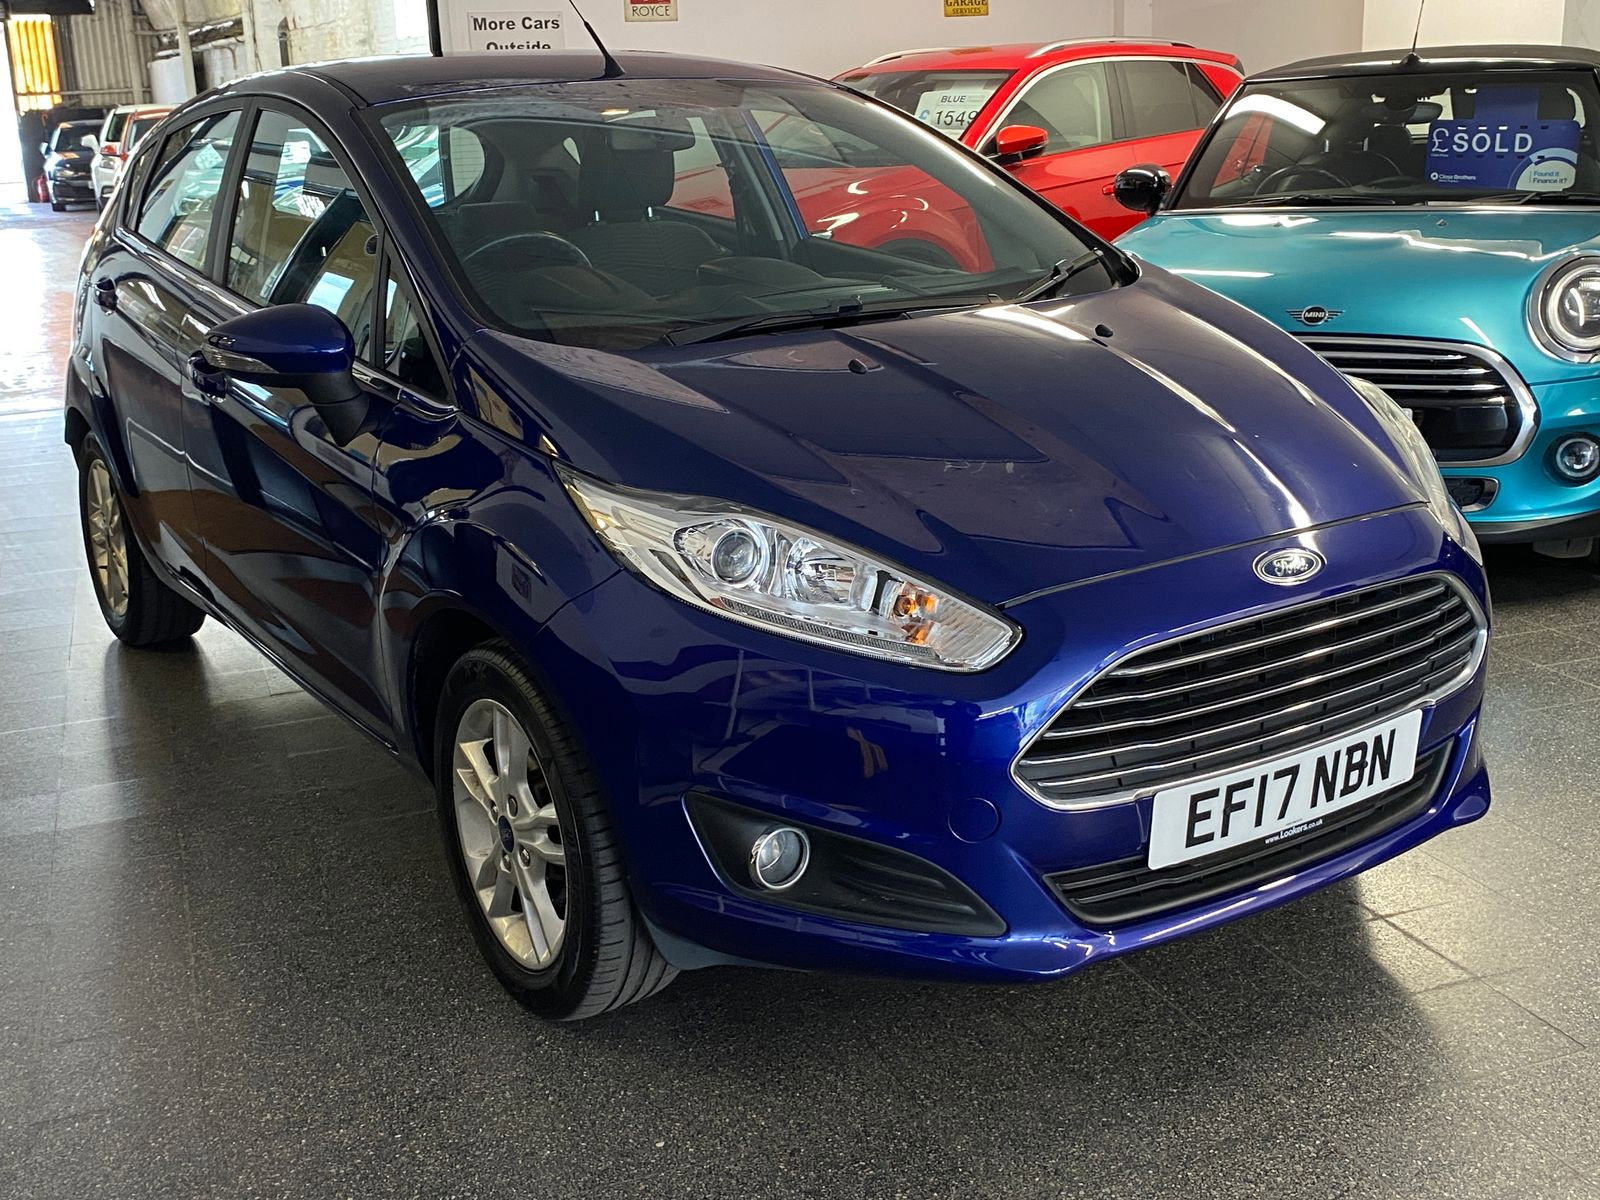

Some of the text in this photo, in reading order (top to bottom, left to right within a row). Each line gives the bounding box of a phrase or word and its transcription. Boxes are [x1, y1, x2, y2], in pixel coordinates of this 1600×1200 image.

[632, 5, 671, 16] ROYCE
[473, 16, 560, 31] More Cars
[941, 95, 966, 103] BLUE
[1184, 728, 1397, 849] EF17 NBN
